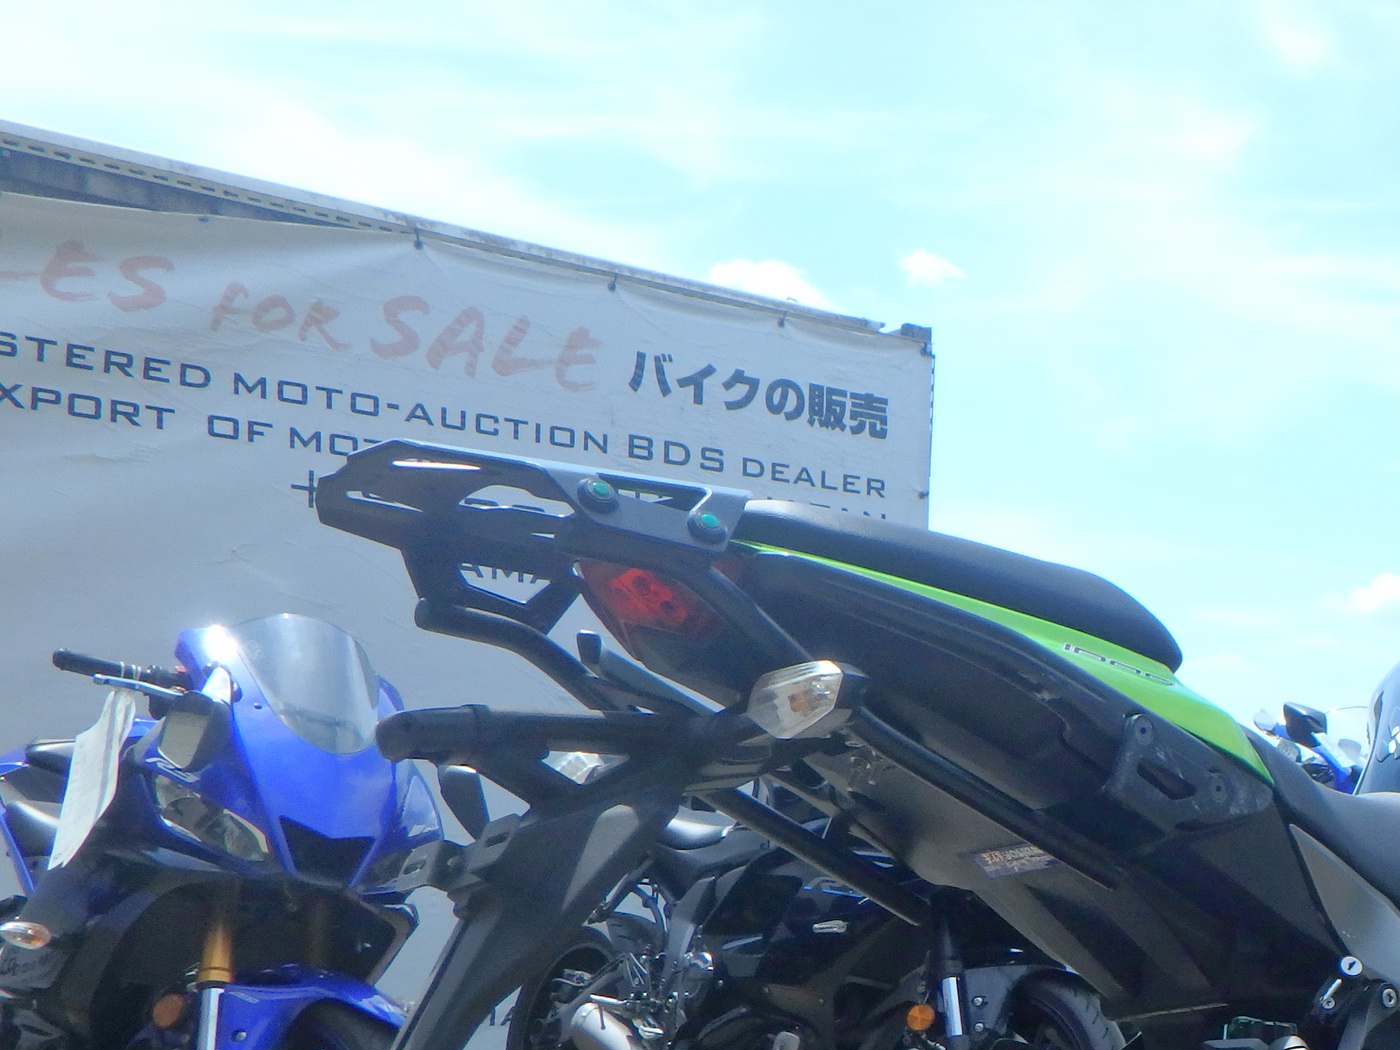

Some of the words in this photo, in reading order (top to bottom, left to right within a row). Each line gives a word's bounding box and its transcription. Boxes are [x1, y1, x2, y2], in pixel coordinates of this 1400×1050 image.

[209, 282, 351, 352] FOR
[369, 294, 601, 392] SALE
[207, 415, 273, 443] OF
[233, 373, 608, 454] MOTO-AUCTION
[628, 435, 725, 474] BDS
[743, 457, 886, 498] DEALER
[628, 351, 889, 440] バイクの販売
